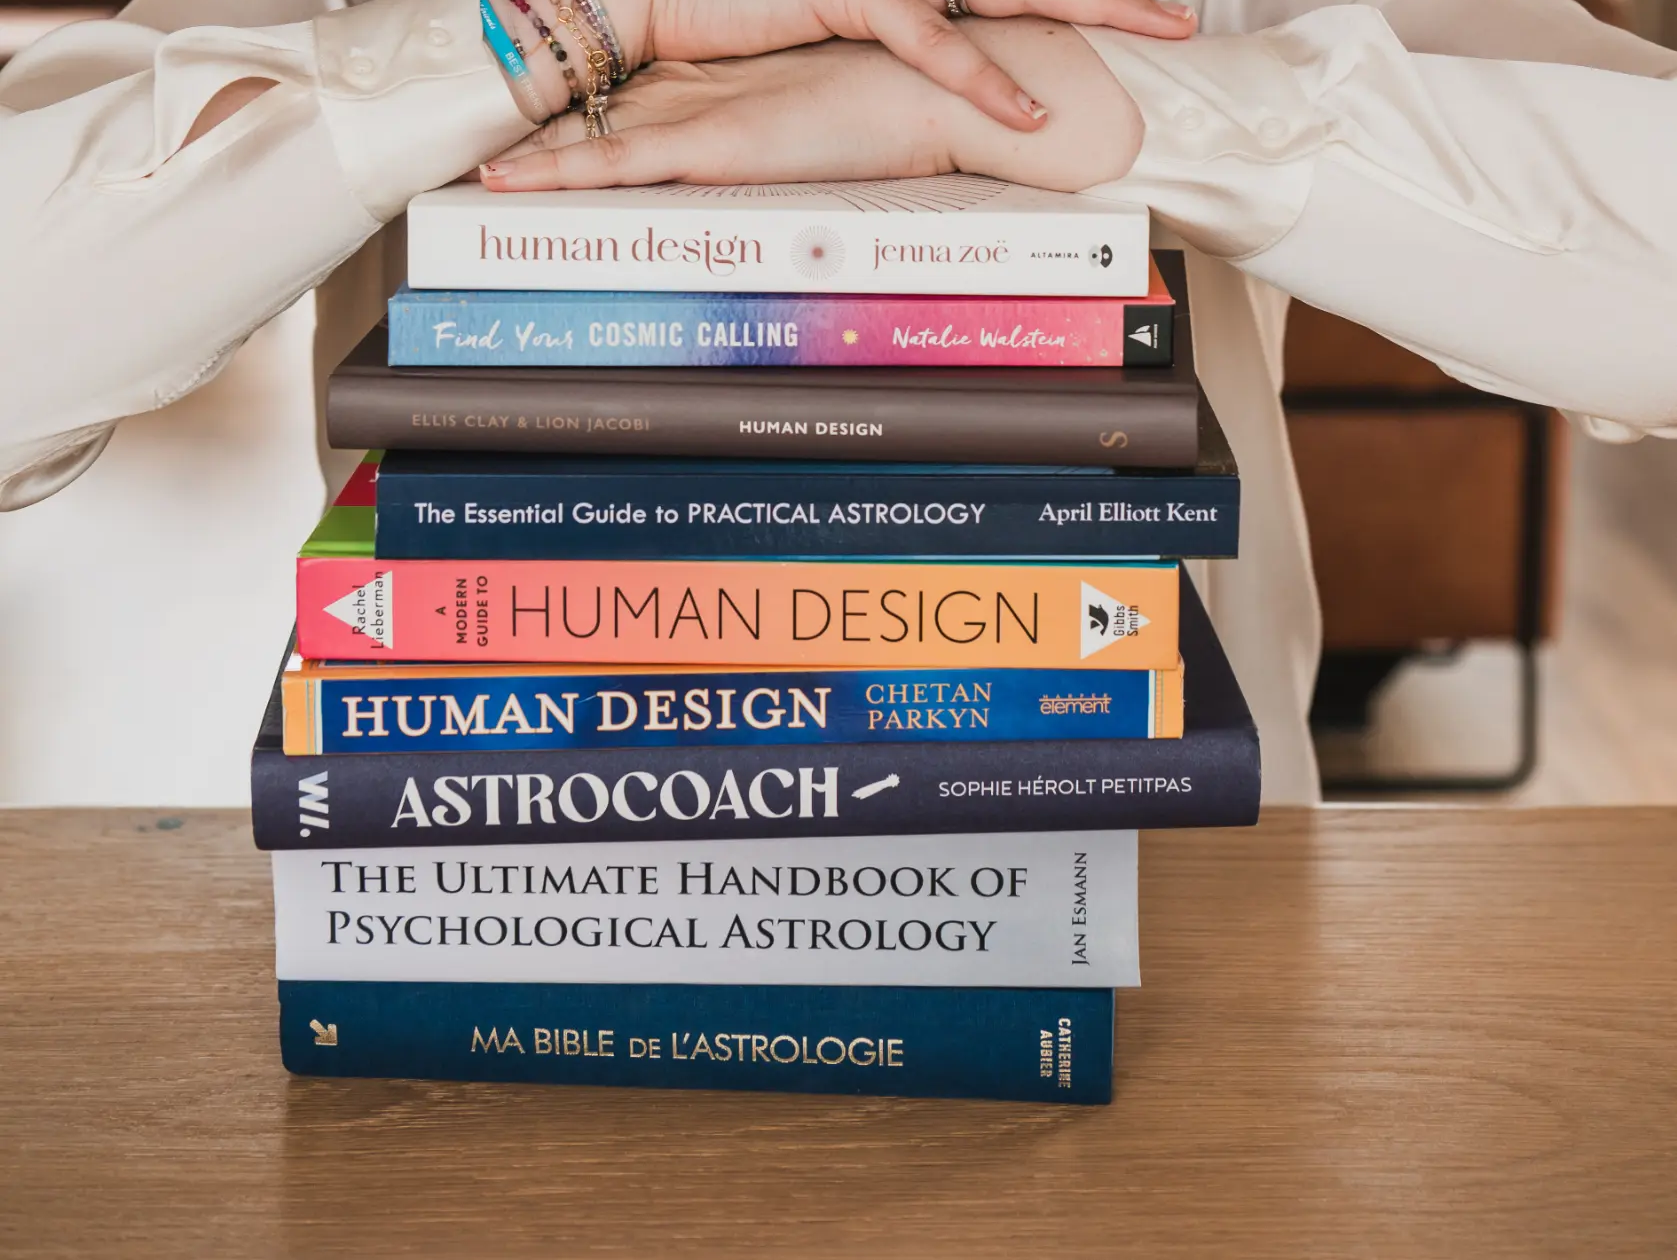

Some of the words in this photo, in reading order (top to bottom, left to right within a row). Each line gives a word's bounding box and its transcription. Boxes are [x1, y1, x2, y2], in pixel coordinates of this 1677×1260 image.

[479, 224, 620, 262] human
[631, 227, 763, 277] design
[875, 239, 950, 269] jenna
[959, 241, 1008, 262] zoë
[433, 320, 503, 349] Find
[516, 322, 573, 351] Your
[588, 321, 684, 348] COSMIC
[696, 321, 799, 348] CALLING
[893, 324, 971, 348] Natalie
[980, 324, 1066, 348] Walstein
[412, 413, 457, 428] ELLIS
[464, 414, 509, 430] CLAY
[517, 416, 529, 430] &
[535, 415, 580, 431] LION
[585, 417, 651, 433] JACOBI
[740, 421, 807, 434] HUMAN
[816, 422, 882, 436] DESIGN
[414, 503, 455, 523] The
[465, 503, 563, 523] Essential
[572, 502, 646, 523] Guide
[656, 506, 678, 523] to
[689, 503, 820, 524] PRACTICAL
[828, 503, 985, 524] ASTROLOGY
[1039, 502, 1092, 525] April
[1099, 502, 1160, 521] Elliott
[1167, 503, 1217, 521] Kent
[476, 575, 488, 594] TO
[352, 585, 366, 635] Rachel
[370, 571, 385, 649] Lieberman
[435, 607, 446, 615] A
[456, 579, 467, 643] MODERN
[476, 600, 489, 647] GUIDE
[512, 586, 759, 640] HUMAN
[793, 589, 1037, 644] DESIGN
[1114, 606, 1125, 635] Gibbs
[1127, 606, 1139, 636] Smith
[866, 683, 990, 704] CHETAN
[1039, 698, 1111, 715] element
[342, 693, 579, 736] HUMAN
[596, 688, 832, 732] DESIGN
[869, 708, 988, 729] PARKYN
[391, 767, 838, 827] ASTROCOACH
[939, 781, 1012, 797] SOPHIE
[1019, 775, 1096, 795] HÉROLT
[1102, 777, 1191, 793] PETITPAS
[971, 868, 1027, 897] OF
[471, 1026, 525, 1053] MA
[535, 1028, 614, 1056] BIBLE
[1040, 1030, 1052, 1077] AUBIER
